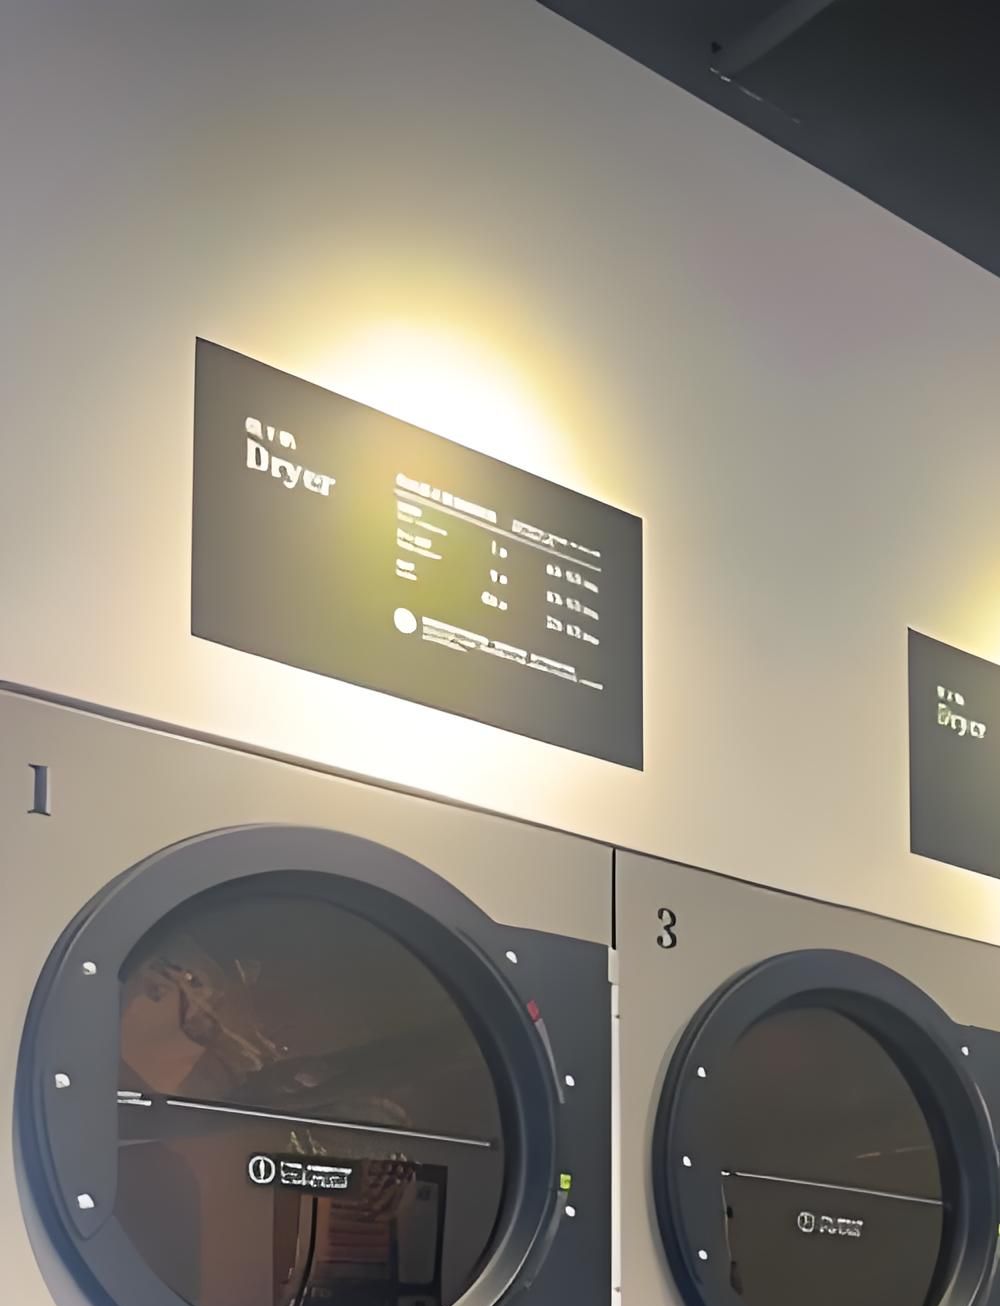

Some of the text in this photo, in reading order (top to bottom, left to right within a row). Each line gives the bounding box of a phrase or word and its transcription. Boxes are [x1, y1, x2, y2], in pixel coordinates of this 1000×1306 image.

[246, 437, 336, 496] Dryer
[27, 763, 51, 816] 1
[657, 907, 677, 949] 3
